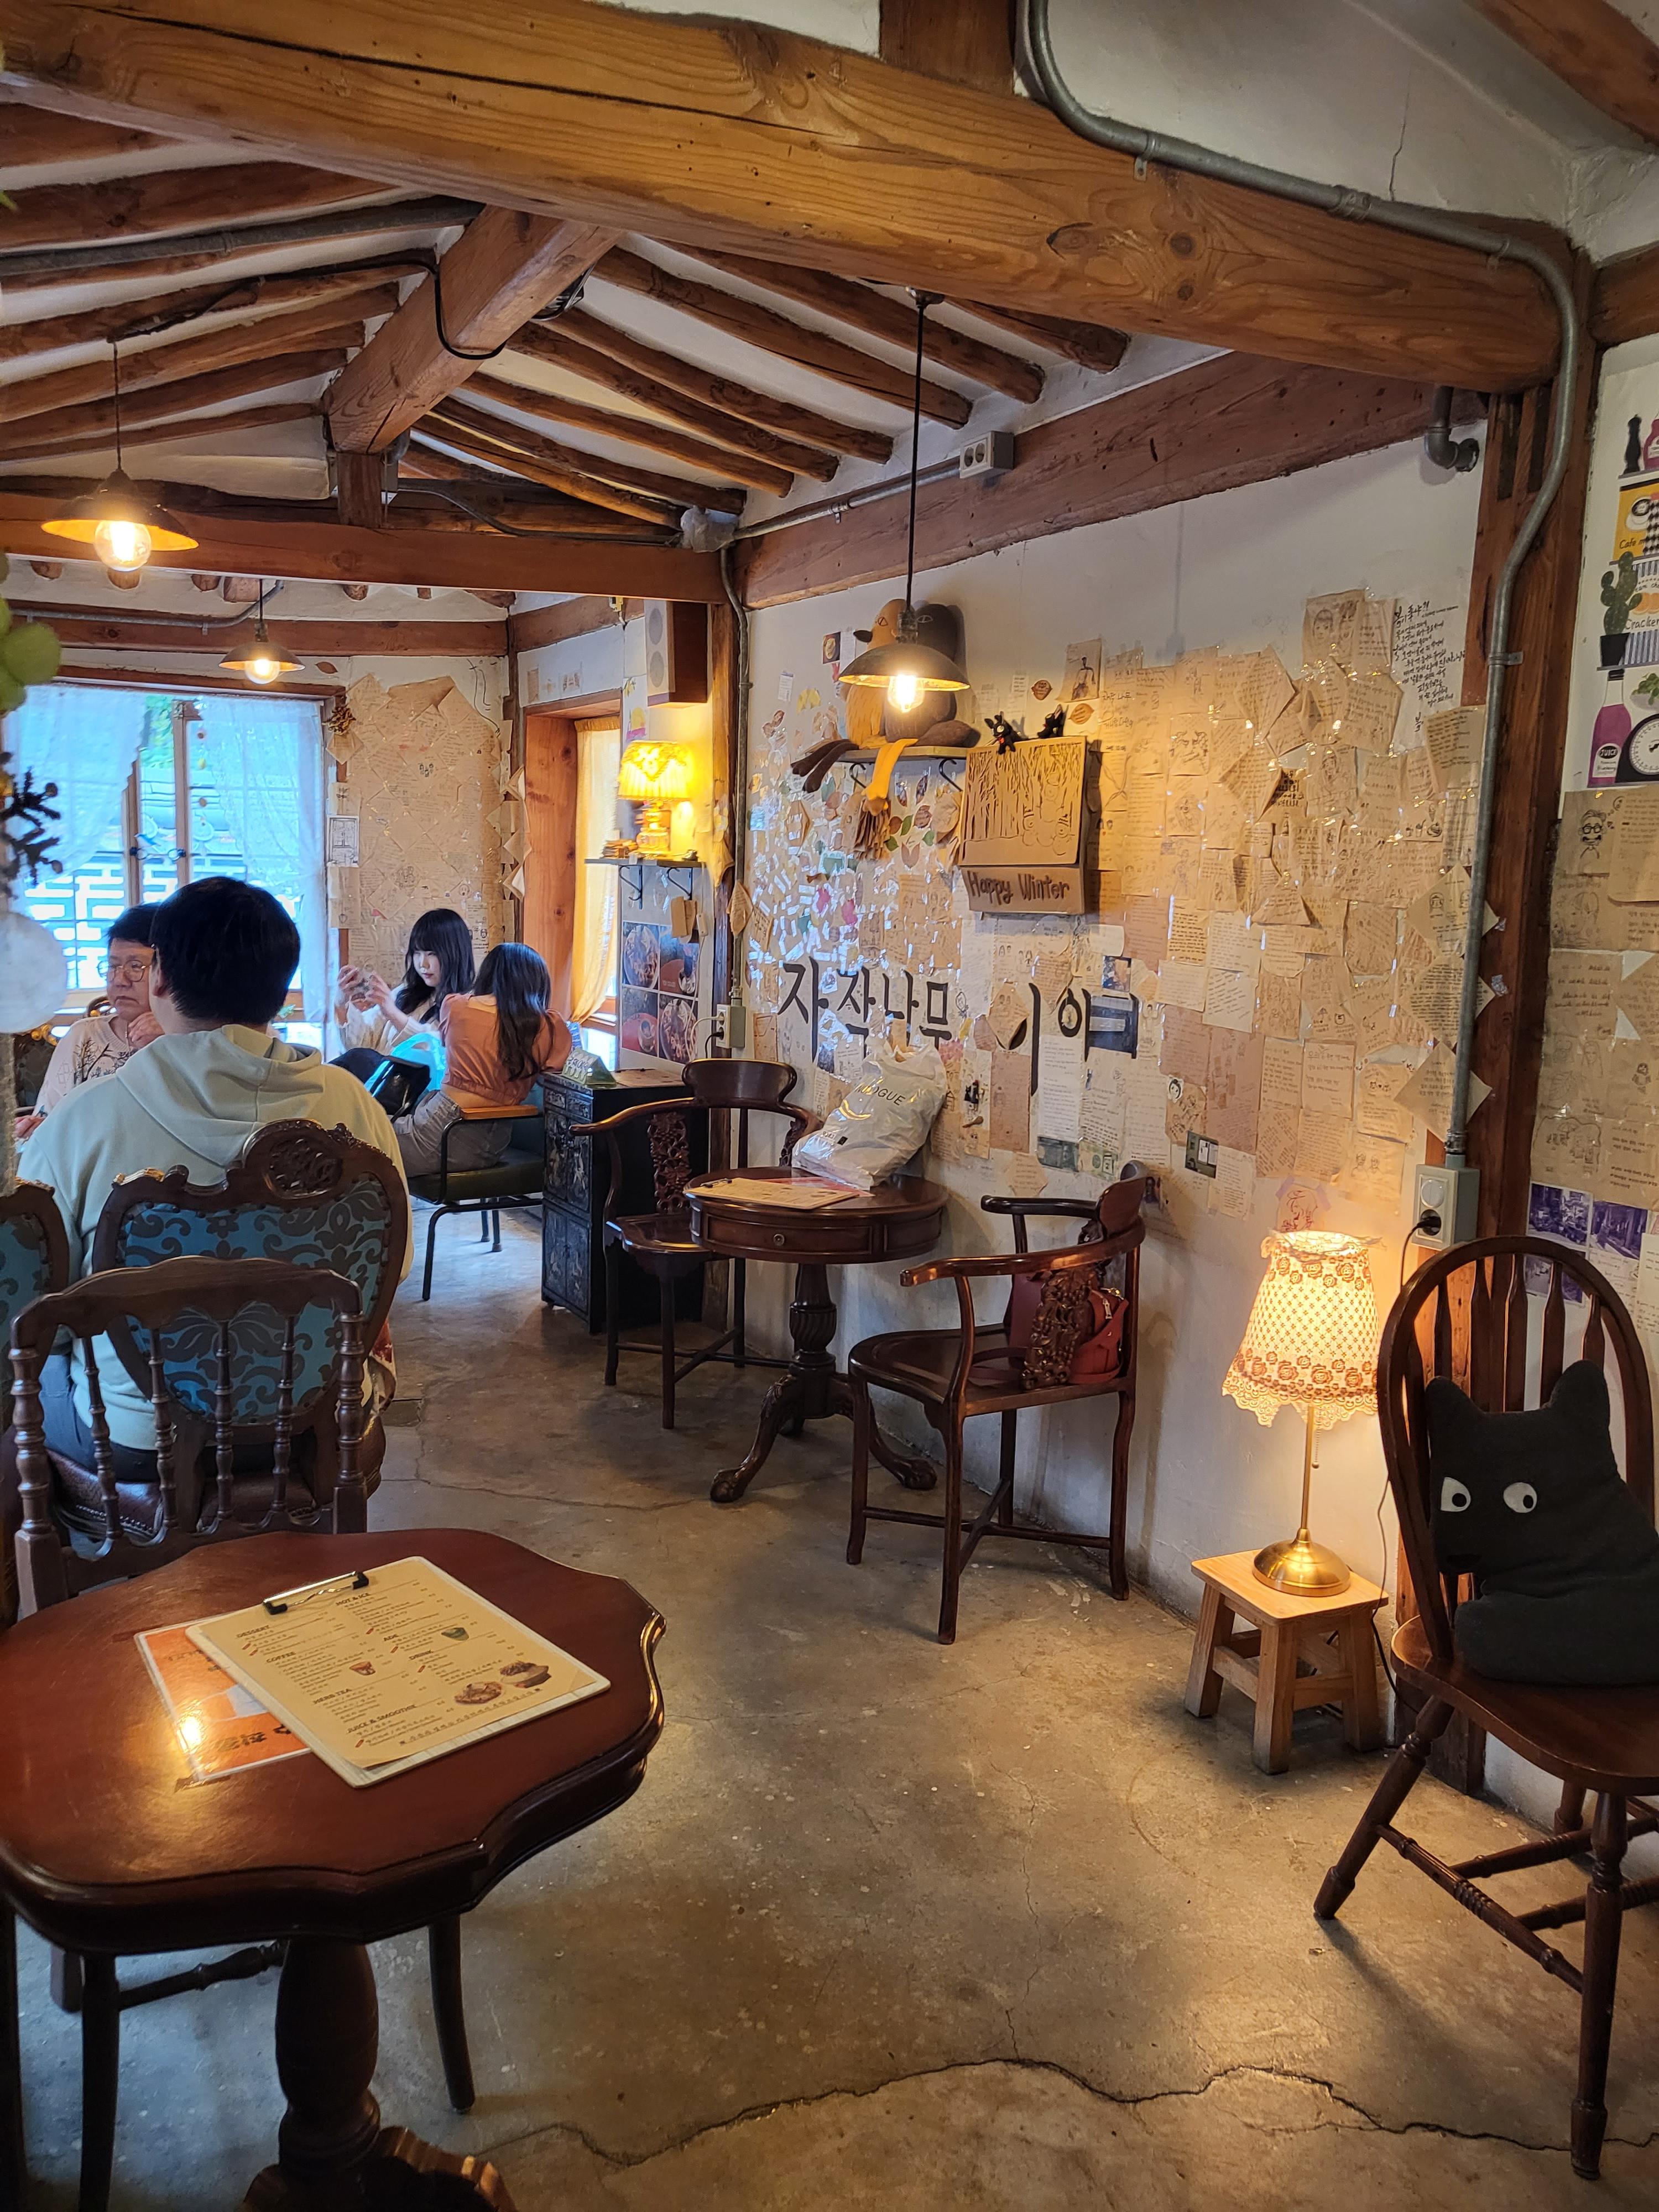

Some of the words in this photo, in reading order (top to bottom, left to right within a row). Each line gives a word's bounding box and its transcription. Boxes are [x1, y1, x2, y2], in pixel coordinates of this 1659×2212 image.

[1619, 538, 1636, 549] Cafe
[967, 870, 1014, 905] Happy
[1018, 872, 1070, 901] Winter
[778, 956, 952, 1063] 자작나무
[266, 1651, 296, 1663] COFFEE
